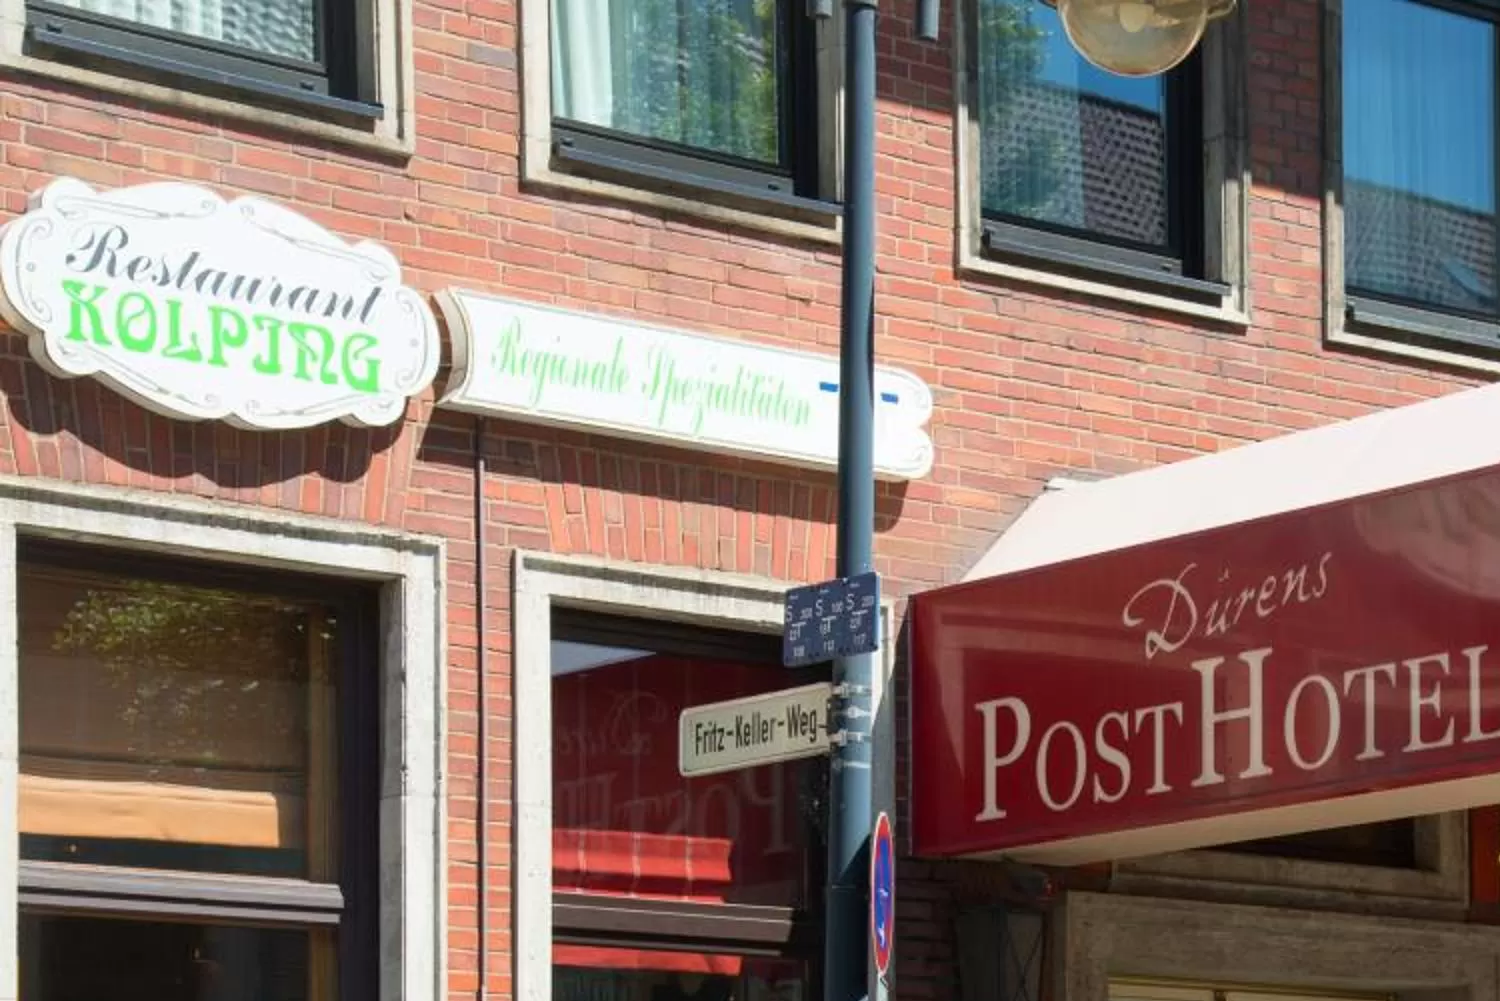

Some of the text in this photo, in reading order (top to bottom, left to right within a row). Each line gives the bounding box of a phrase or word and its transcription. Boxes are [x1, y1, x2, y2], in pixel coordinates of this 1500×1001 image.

[65, 222, 384, 325] Restaurant
[62, 278, 382, 394] KOLPING
[1122, 551, 1334, 660] Dürens
[694, 703, 818, 757] Fritz-Keller-Weg
